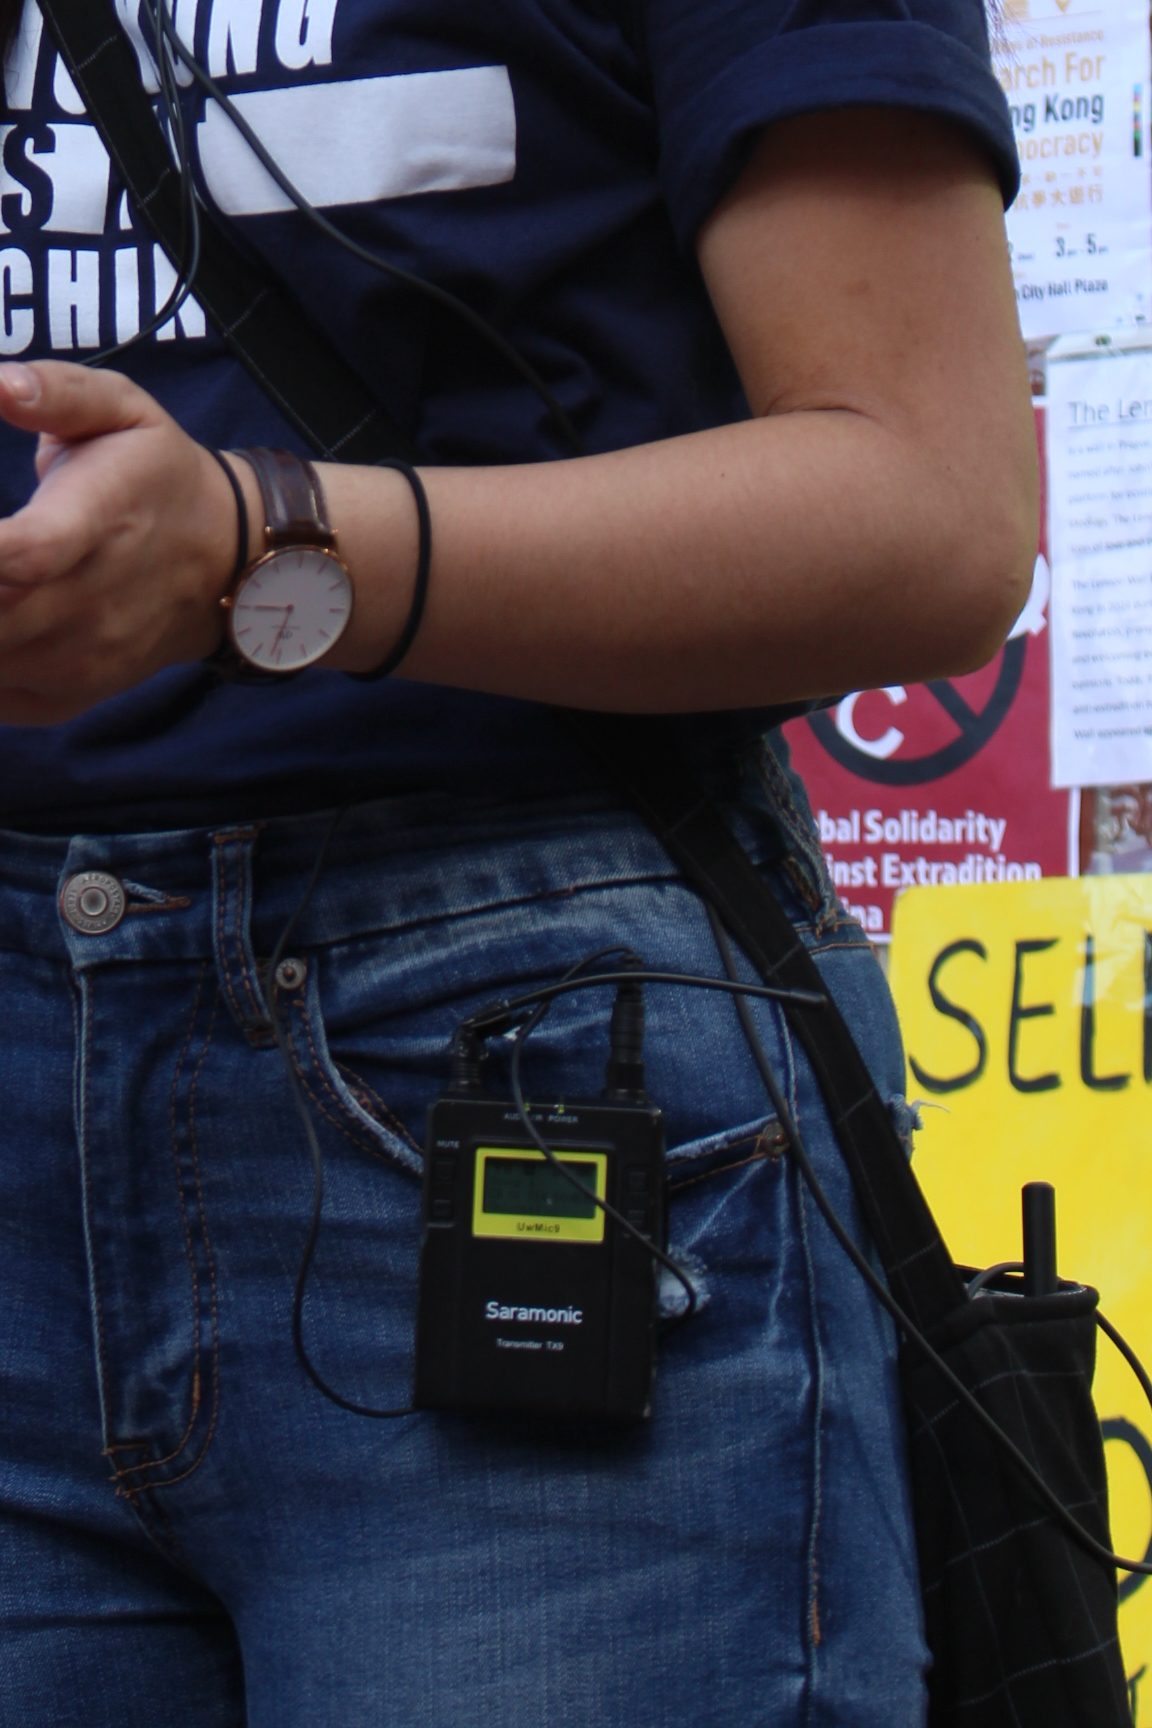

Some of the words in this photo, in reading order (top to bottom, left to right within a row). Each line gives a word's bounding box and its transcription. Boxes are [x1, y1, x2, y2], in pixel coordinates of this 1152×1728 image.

[991, 56, 1056, 92] arch
[1065, 52, 1106, 83] For
[1010, 103, 1036, 133] ng
[1045, 93, 1104, 124] Kong
[1018, 130, 1104, 162] ocracy
[1022, 285, 1044, 301] City
[1048, 280, 1072, 297] Hall
[1074, 277, 1109, 293] Plaza
[1068, 399, 1110, 424] The
[817, 809, 860, 843] bal
[864, 809, 1007, 852] Solidarity
[827, 855, 878, 887] inst
[881, 853, 1043, 887] Extradition
[909, 936, 1152, 1095] SEL
[548, 1113, 580, 1123] POWER
[436, 1139, 460, 1149] MUTE
[484, 1299, 584, 1325] Saramonic
[495, 1337, 543, 1350] Transmitter
[546, 1340, 565, 1351] TX9
